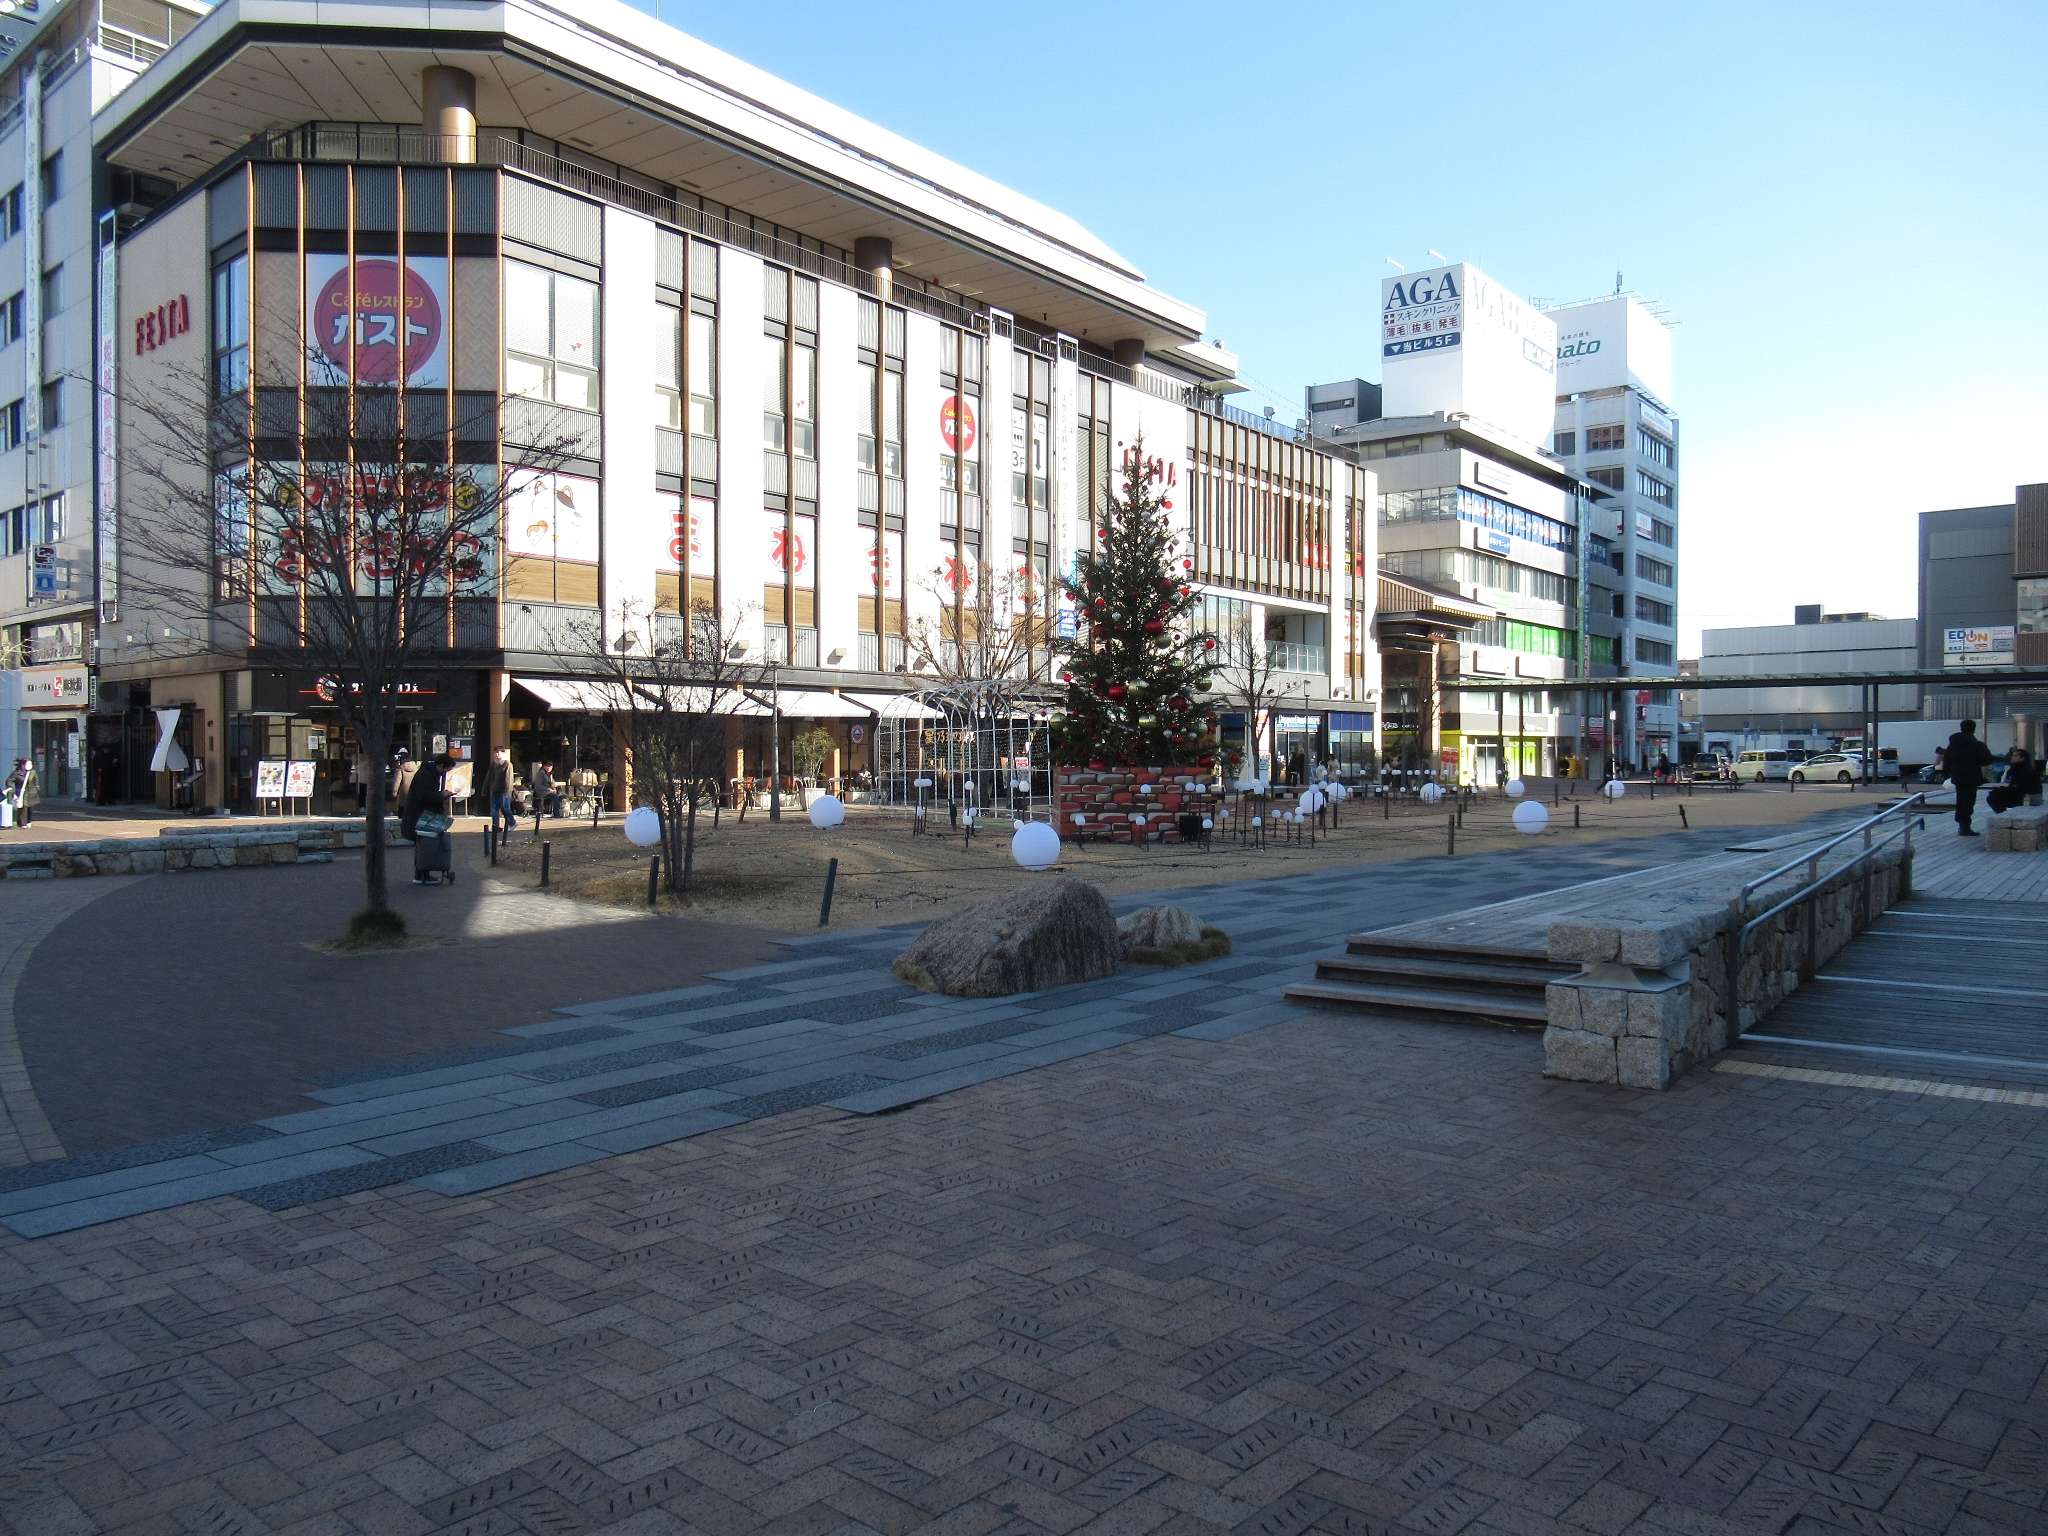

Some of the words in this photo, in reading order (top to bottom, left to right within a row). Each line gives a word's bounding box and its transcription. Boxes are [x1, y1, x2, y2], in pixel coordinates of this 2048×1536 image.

[1384, 272, 1461, 310] AGA
[135, 294, 190, 356] FESTA
[1397, 303, 1460, 321] スキンクリニック
[333, 313, 429, 346] ガスト
[1403, 335, 1453, 352] 当ビル5F
